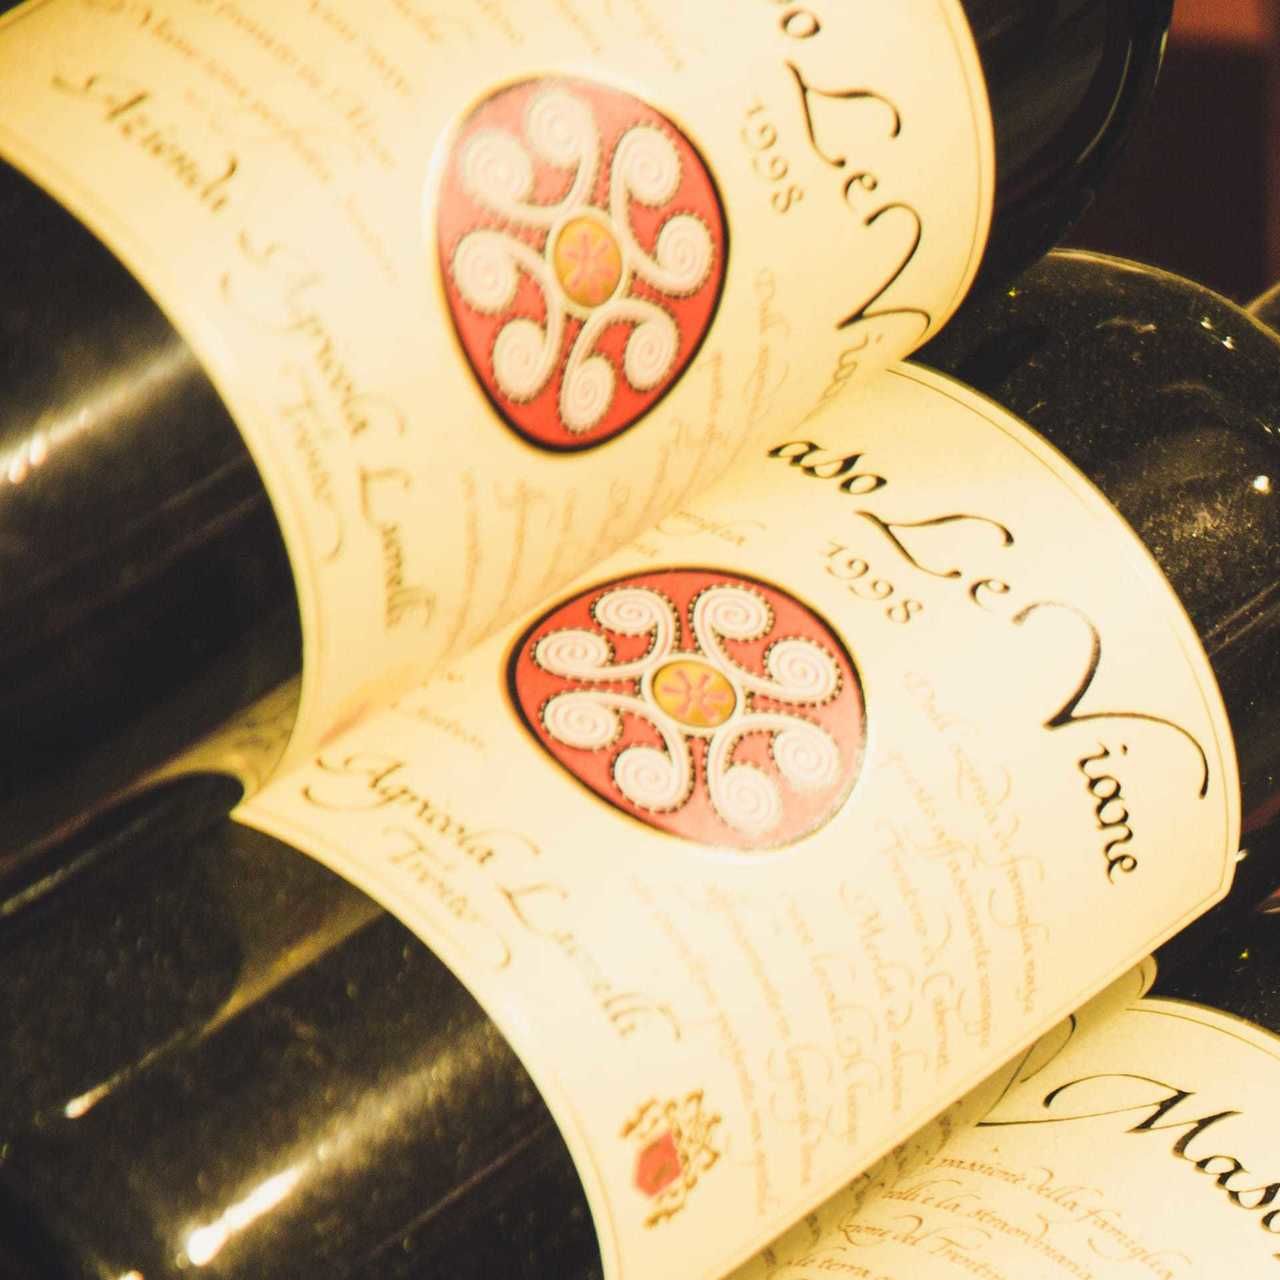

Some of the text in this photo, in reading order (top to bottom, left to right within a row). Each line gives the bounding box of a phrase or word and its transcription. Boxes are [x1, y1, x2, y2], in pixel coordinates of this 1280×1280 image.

[740, 97, 804, 215] 1998
[824, 540, 924, 625] 1998
[767, 440, 887, 495] aso
[856, 509, 1014, 613] Le
[1012, 601, 1208, 884] Viane
